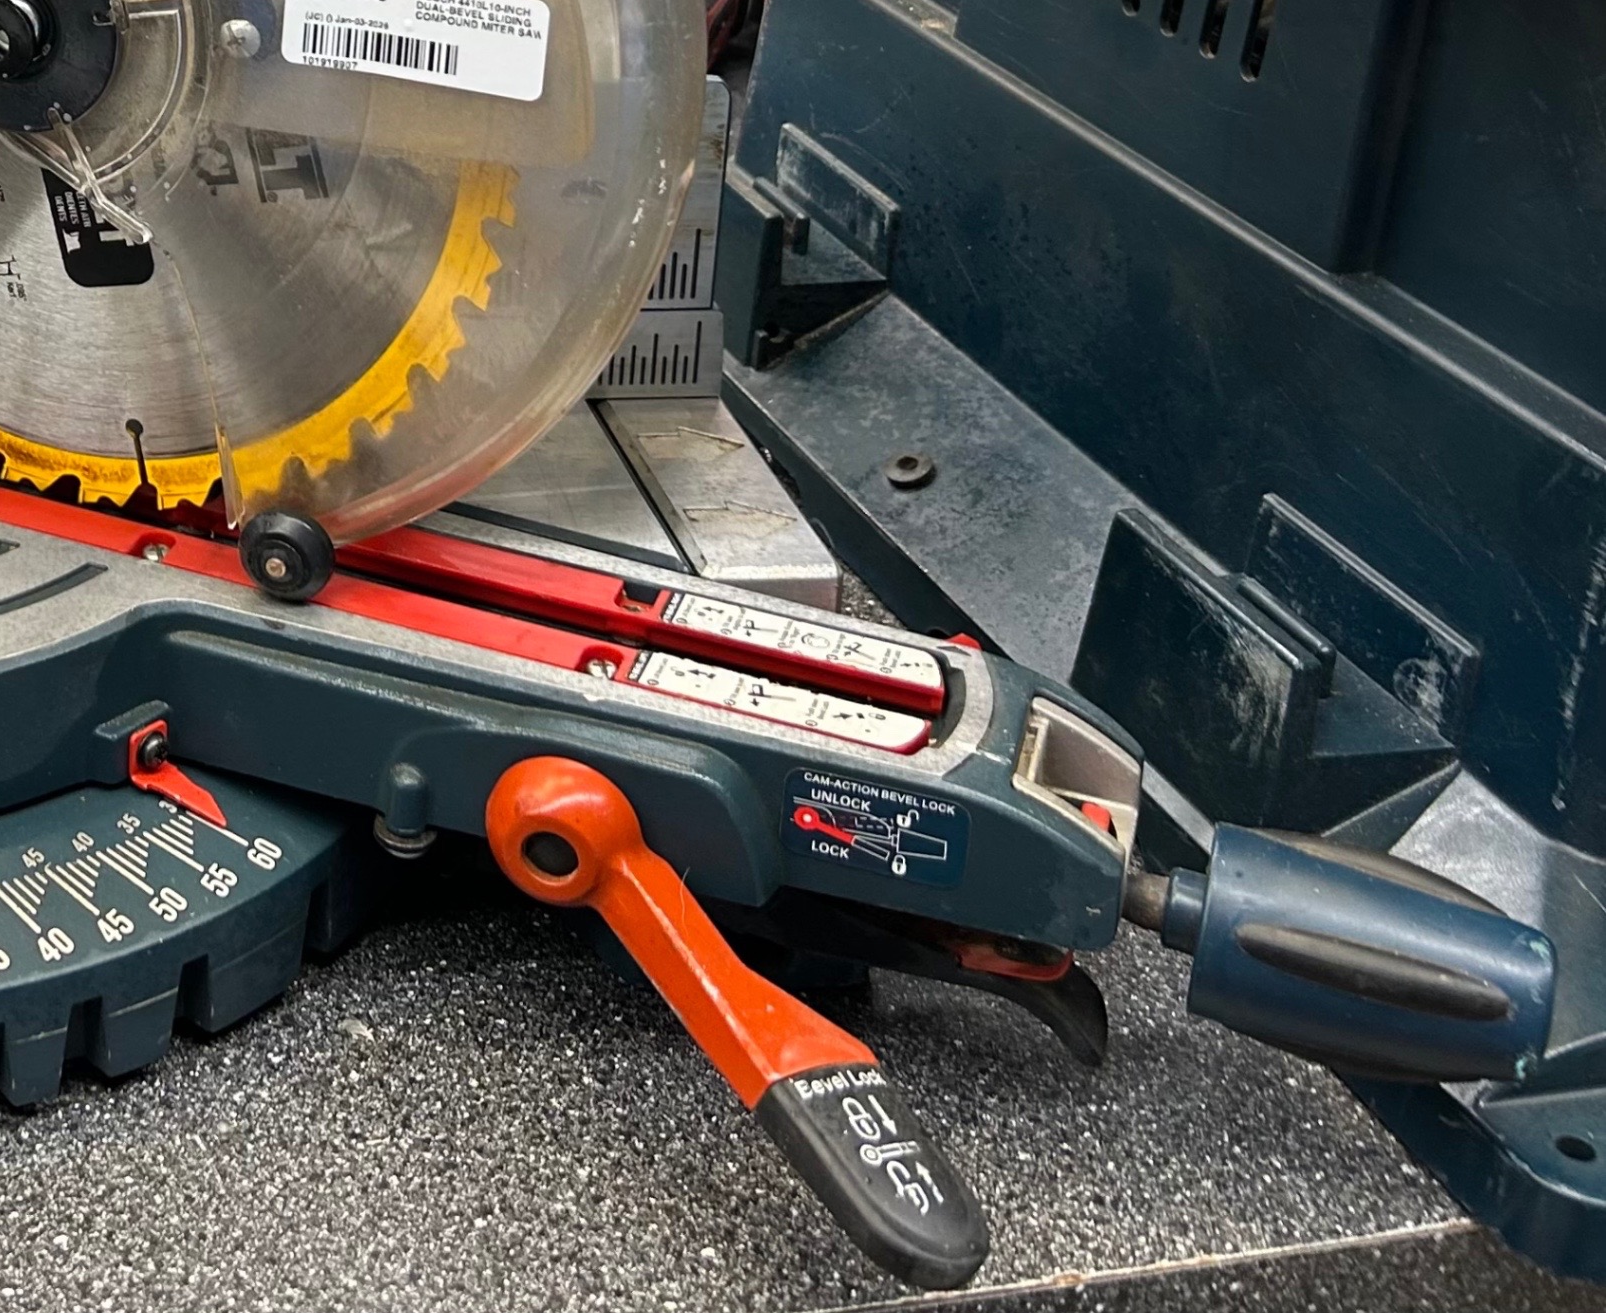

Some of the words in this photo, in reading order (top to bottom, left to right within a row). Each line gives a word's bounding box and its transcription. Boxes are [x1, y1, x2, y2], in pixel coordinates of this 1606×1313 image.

[416, 1, 484, 20] DUAL-BEVEL
[488, 13, 531, 27] SLIDING
[416, 11, 478, 29] COMPOUND
[481, 22, 515, 35] MITER
[54, 196, 67, 222] DENTS
[803, 771, 880, 799] CAM-ACTION
[880, 788, 918, 809] BEVEL
[919, 797, 956, 816] LOCK
[810, 788, 871, 812] UNLOCK
[20, 847, 46, 869] 45
[72, 830, 95, 852] 40
[117, 813, 142, 835] 35
[158, 800, 178, 814] 3
[811, 840, 850, 860] LOCK
[36, 926, 76, 963] 40
[96, 909, 135, 944] 45
[148, 888, 189, 922] 50
[200, 863, 238, 897] 55
[246, 837, 283, 871] 60
